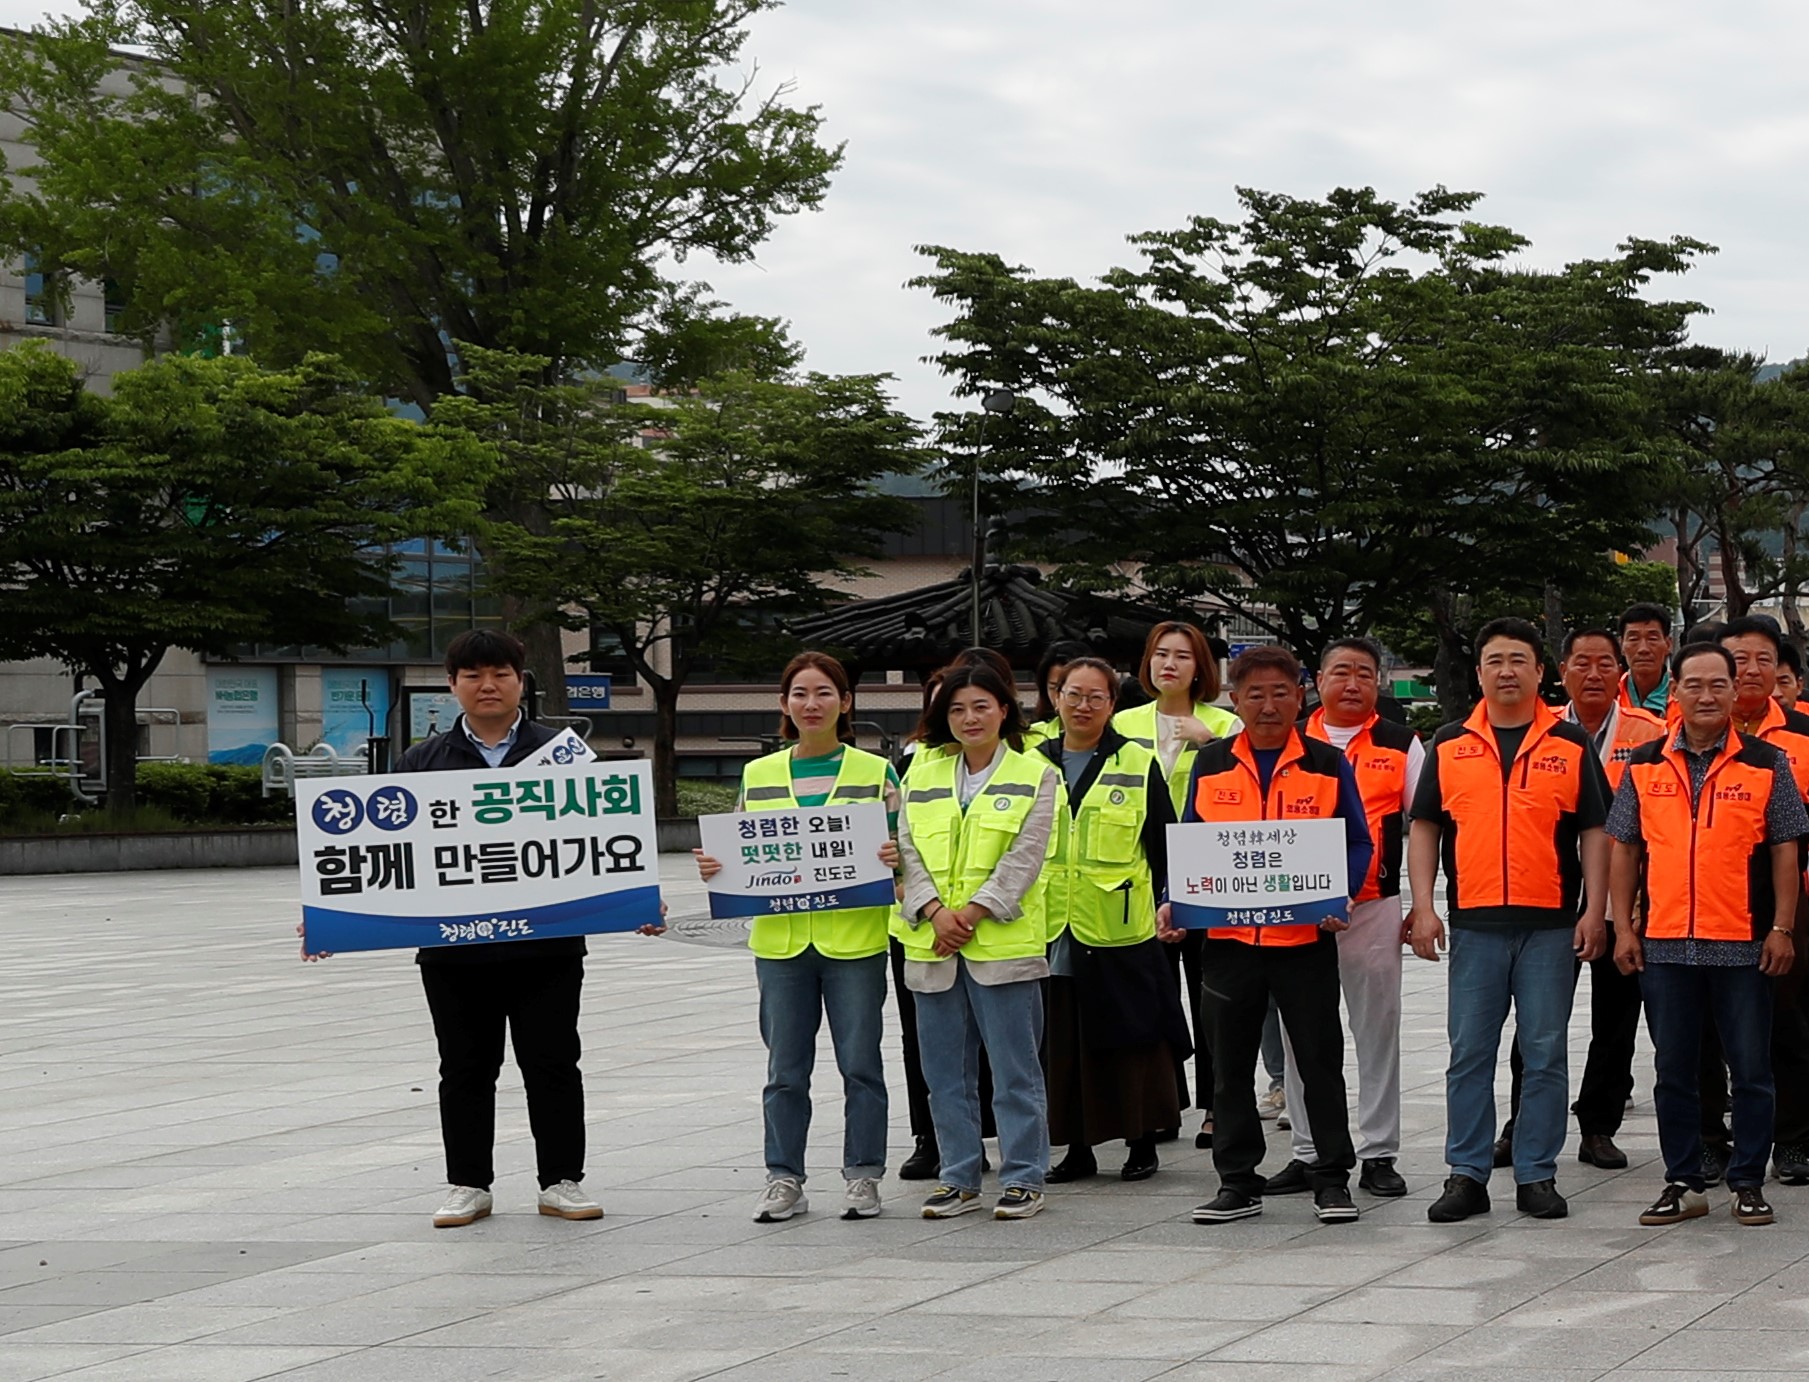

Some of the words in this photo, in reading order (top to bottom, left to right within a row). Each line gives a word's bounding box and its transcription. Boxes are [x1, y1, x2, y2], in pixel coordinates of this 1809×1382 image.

[471, 774, 643, 825] 공직사회
[738, 816, 801, 840] 청렴한
[808, 815, 851, 834] 오늘!
[741, 842, 804, 866] 떳떳한
[811, 840, 853, 859] 내일!
[1232, 851, 1283, 869] 청렴은
[313, 842, 416, 896] 함께
[433, 835, 646, 887] 만들어가요
[813, 865, 857, 882] 진도군
[746, 871, 793, 889] Jindo
[1186, 876, 1228, 895] 노력이
[1232, 876, 1258, 894] 아닌
[1263, 873, 1332, 893] 생활입니다
